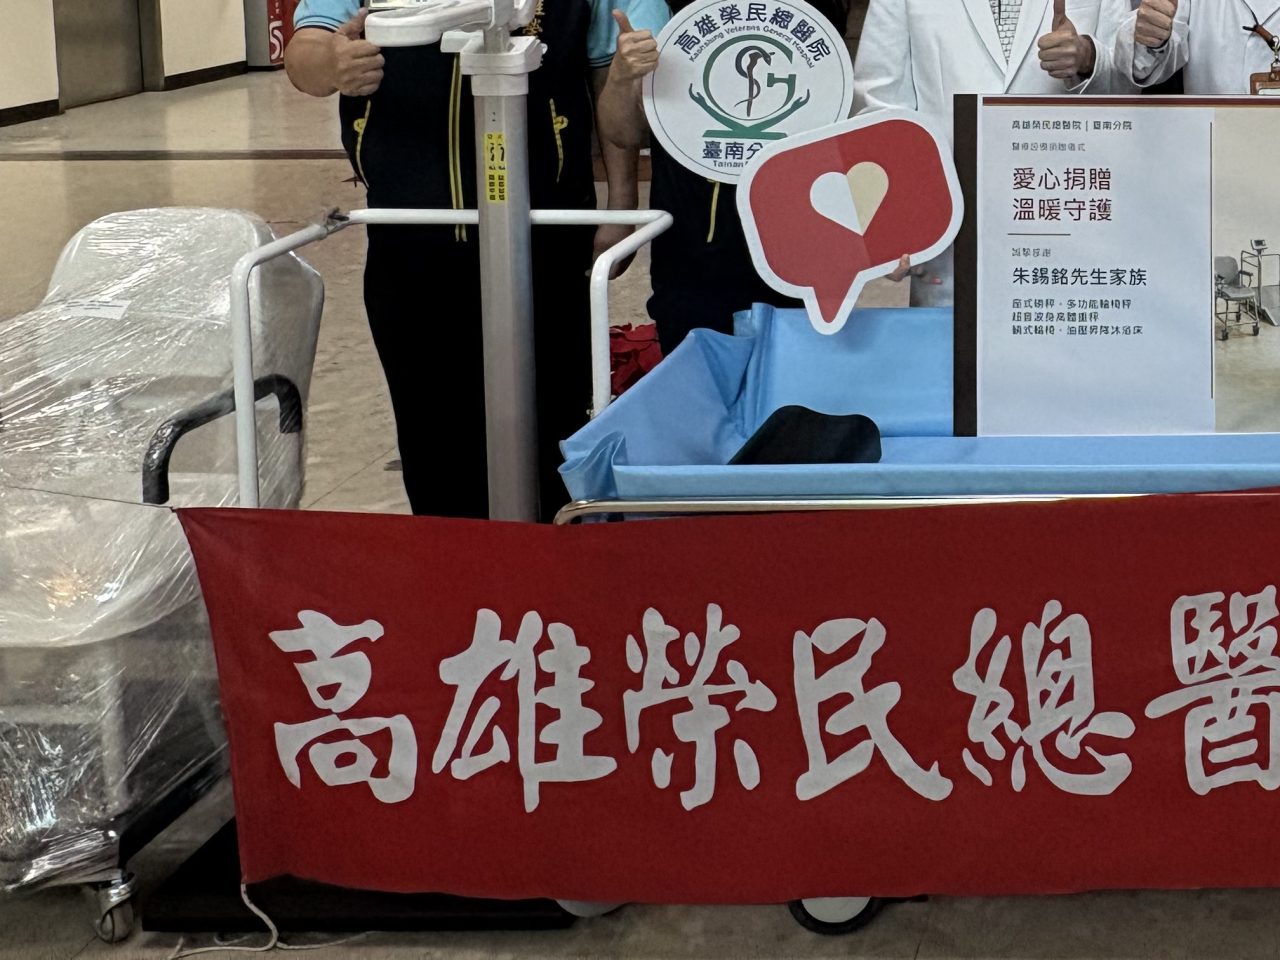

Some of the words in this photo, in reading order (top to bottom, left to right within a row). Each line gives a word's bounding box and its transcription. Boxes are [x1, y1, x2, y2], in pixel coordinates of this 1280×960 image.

[674, 3, 831, 62] 高雄榮民總醫院
[1013, 167, 1112, 191] 愛心捐贈
[1013, 198, 1113, 222] 溫暖守護
[1012, 267, 1147, 286] 朱錫銘先生家族
